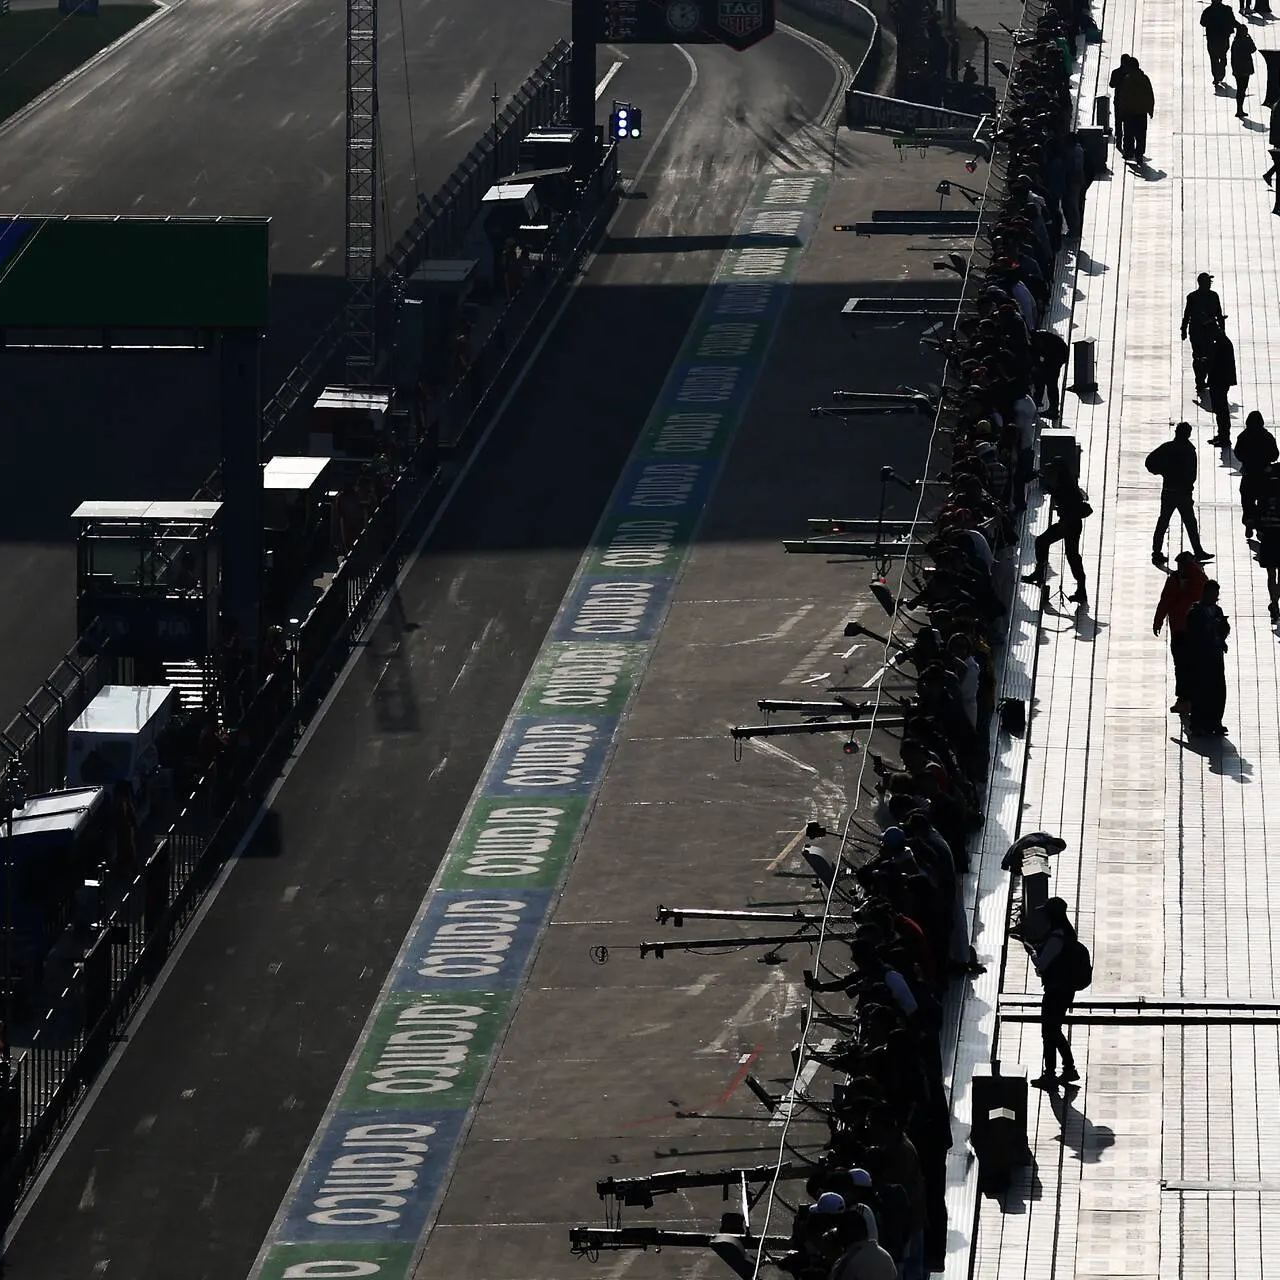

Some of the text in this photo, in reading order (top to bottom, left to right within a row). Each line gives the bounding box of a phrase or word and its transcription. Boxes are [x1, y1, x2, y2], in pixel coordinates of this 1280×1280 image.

[723, 1, 760, 15] TAG
[571, 582, 655, 634] aramco
[539, 649, 628, 706] aramco
[502, 723, 598, 787] aramco
[462, 806, 565, 877] aramco
[417, 899, 527, 978] aramco
[366, 1004, 488, 1094] aramco
[306, 1122, 437, 1226] aramco
